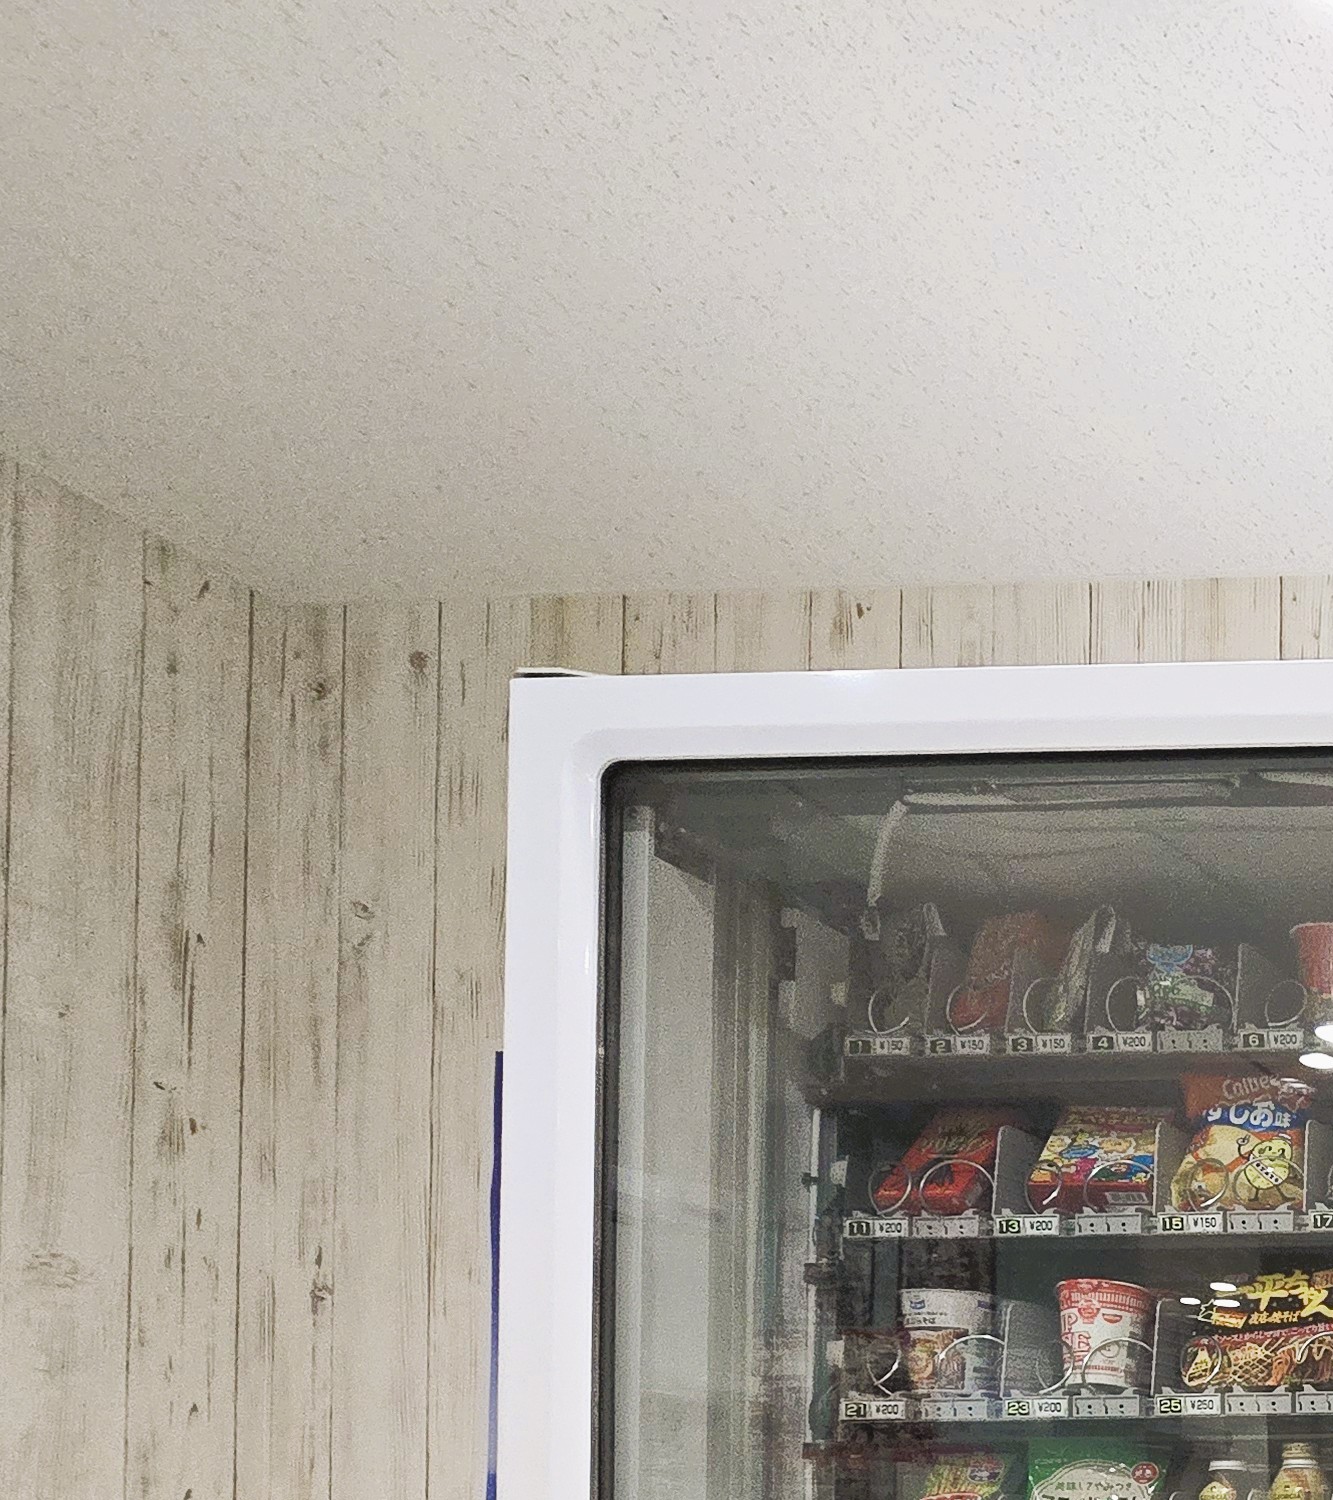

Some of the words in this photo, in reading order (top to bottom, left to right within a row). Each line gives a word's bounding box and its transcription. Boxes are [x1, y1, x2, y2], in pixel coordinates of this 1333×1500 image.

[1029, 1219, 1053, 1232] ¥200
[1193, 1215, 1217, 1229] ¥150
[1037, 1401, 1062, 1414] ¥200
